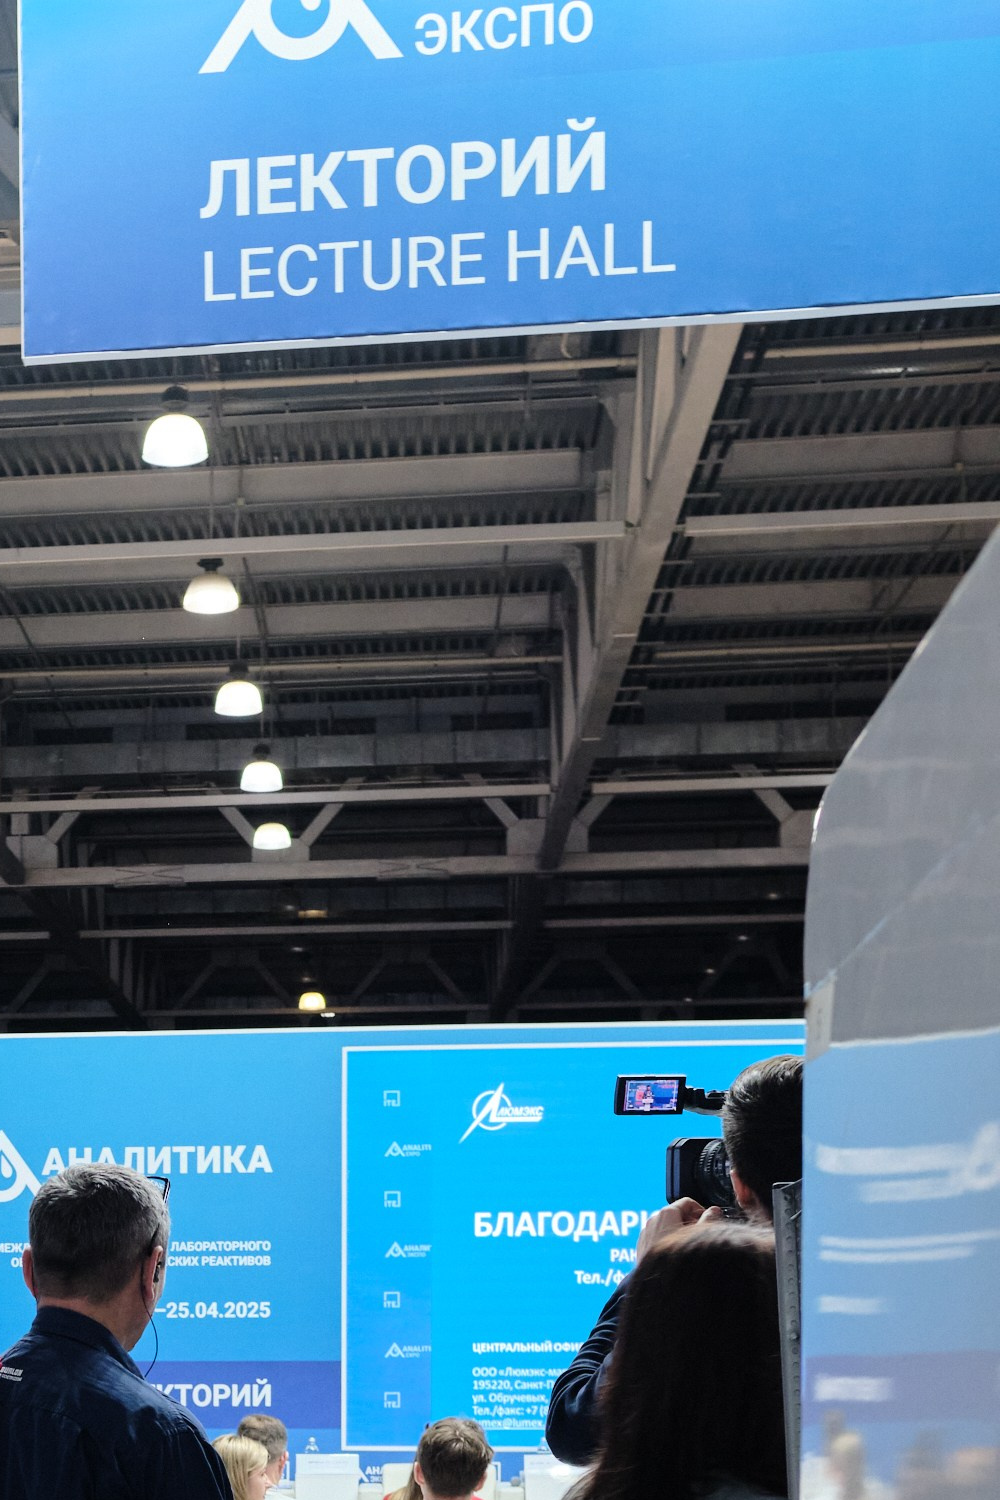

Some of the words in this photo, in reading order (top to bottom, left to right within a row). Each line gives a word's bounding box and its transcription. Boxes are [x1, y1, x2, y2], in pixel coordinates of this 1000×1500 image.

[415, 1, 594, 57] ЭКСПО
[200, 117, 606, 219] ЛЕКТОРИЙ
[203, 231, 486, 302] LECTURE
[508, 220, 676, 282] HALL
[41, 1145, 273, 1176] АНАЛИТИКА
[170, 1241, 271, 1252] ЛАБОРАТОРНОГО
[166, 1256, 199, 1266] СКИХ
[202, 1256, 271, 1266] РЕАКТИВОВ
[472, 1341, 553, 1355] ЦЕНТРАЛЬНЫЙ
[472, 1367, 497, 1377] ООО
[152, 1379, 272, 1408] КТОРИЙ
[473, 1380, 512, 1391] 195220,
[514, 1380, 555, 1390] Санкт-П
